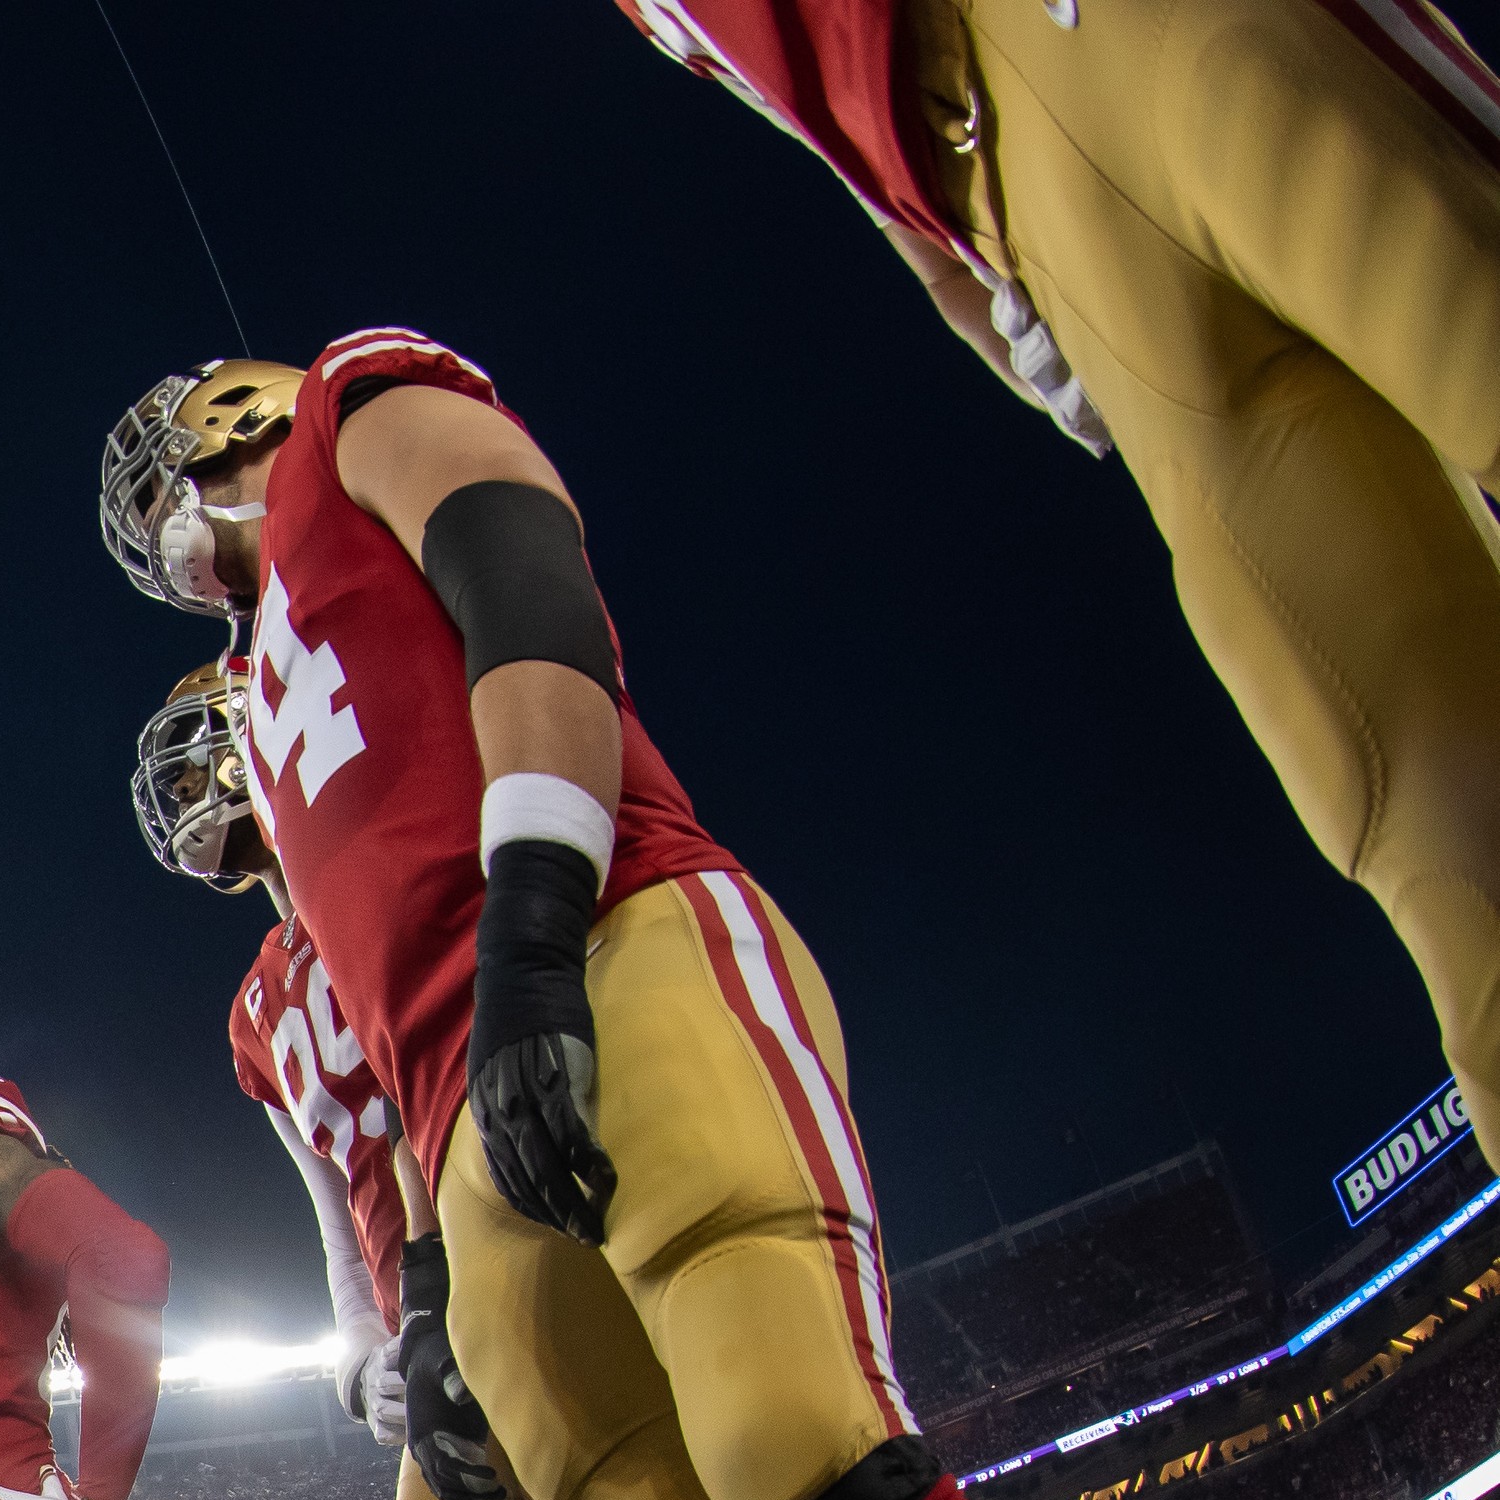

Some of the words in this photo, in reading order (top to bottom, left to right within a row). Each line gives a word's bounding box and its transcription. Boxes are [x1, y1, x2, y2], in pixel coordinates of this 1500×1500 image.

[1344, 1132, 1418, 1211] BUD
[1076, 1345, 1106, 1364] GUEST
[1062, 1423, 1112, 1448] RECEIVING
